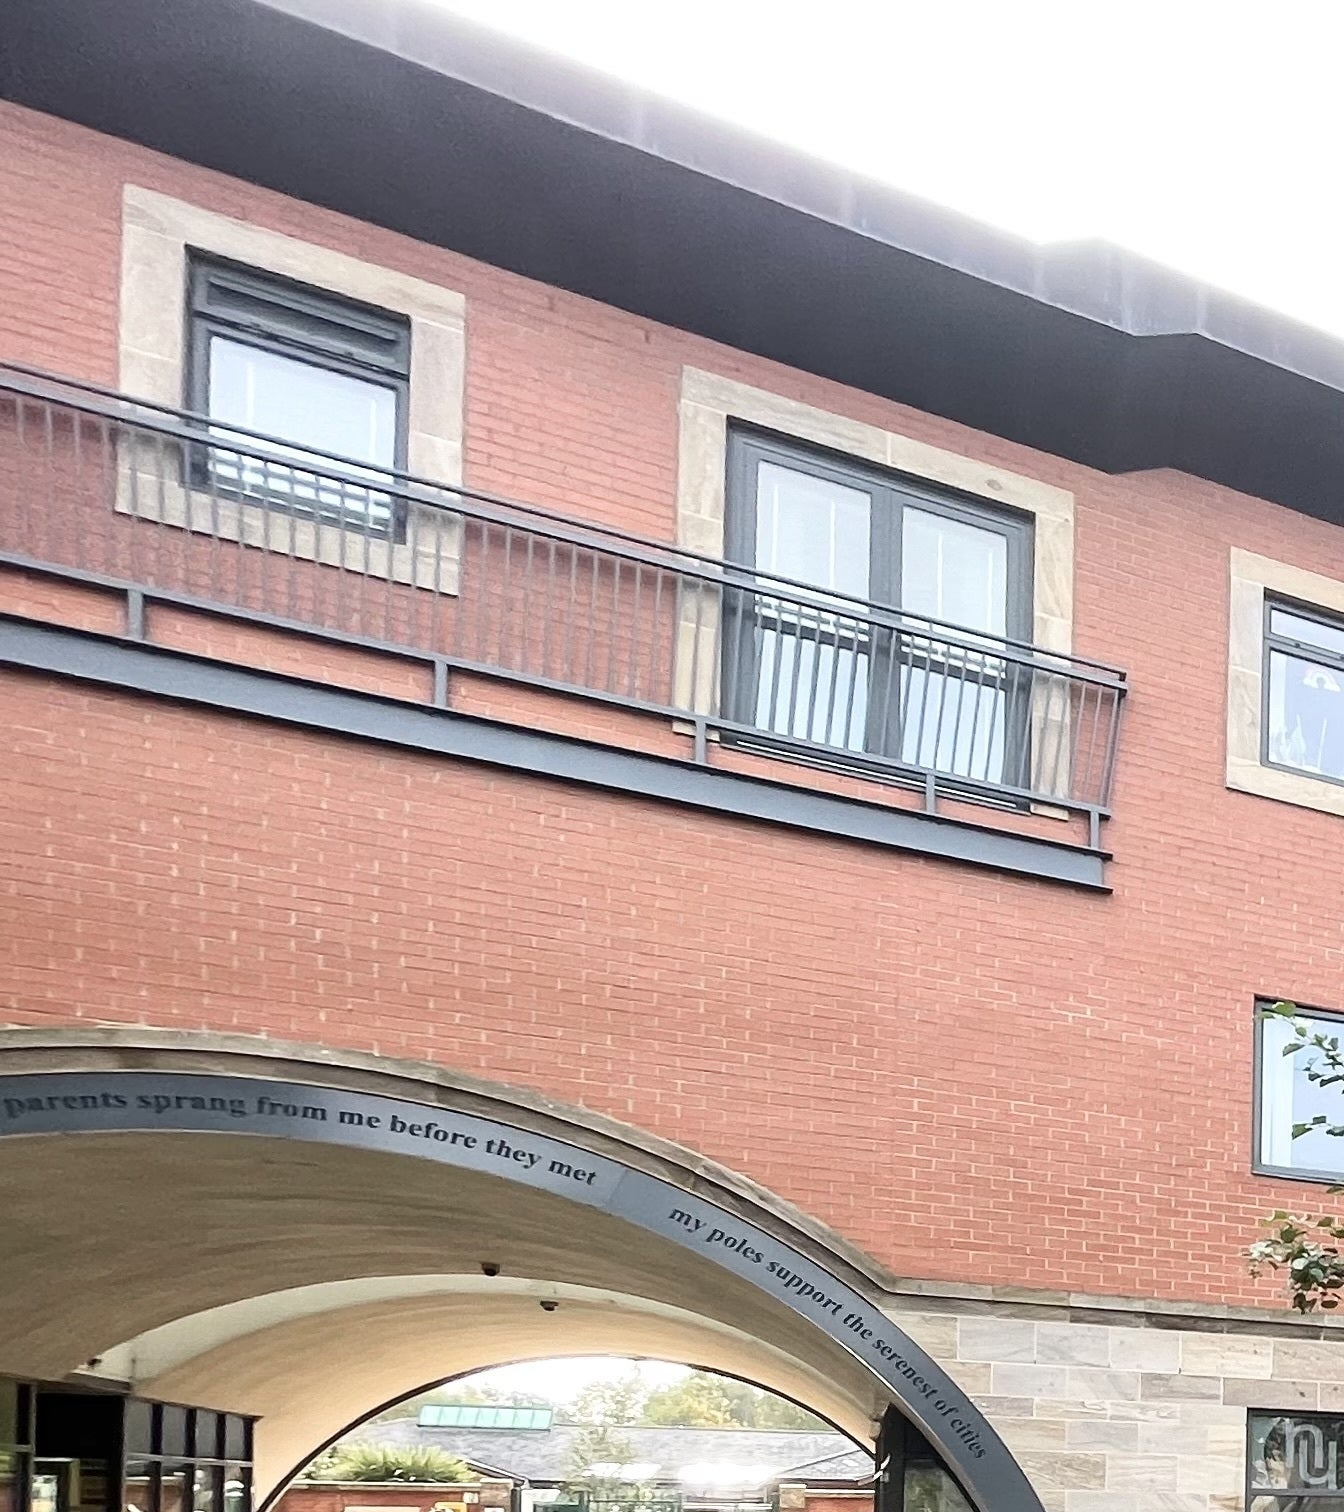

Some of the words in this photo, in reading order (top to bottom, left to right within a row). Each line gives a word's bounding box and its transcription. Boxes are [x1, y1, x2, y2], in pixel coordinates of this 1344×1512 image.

[3, 1092, 127, 1118] parents
[136, 1094, 247, 1118] sprang
[257, 1096, 327, 1121] from
[338, 1110, 382, 1129] me
[390, 1115, 477, 1149] before
[486, 1139, 542, 1169] they
[548, 1159, 597, 1186] met
[668, 1208, 707, 1233] my
[706, 1228, 765, 1264] poles
[766, 1261, 845, 1316] support
[843, 1313, 873, 1340] the
[872, 1339, 938, 1399] serenest
[934, 1399, 959, 1416] of
[951, 1418, 986, 1458] cities
